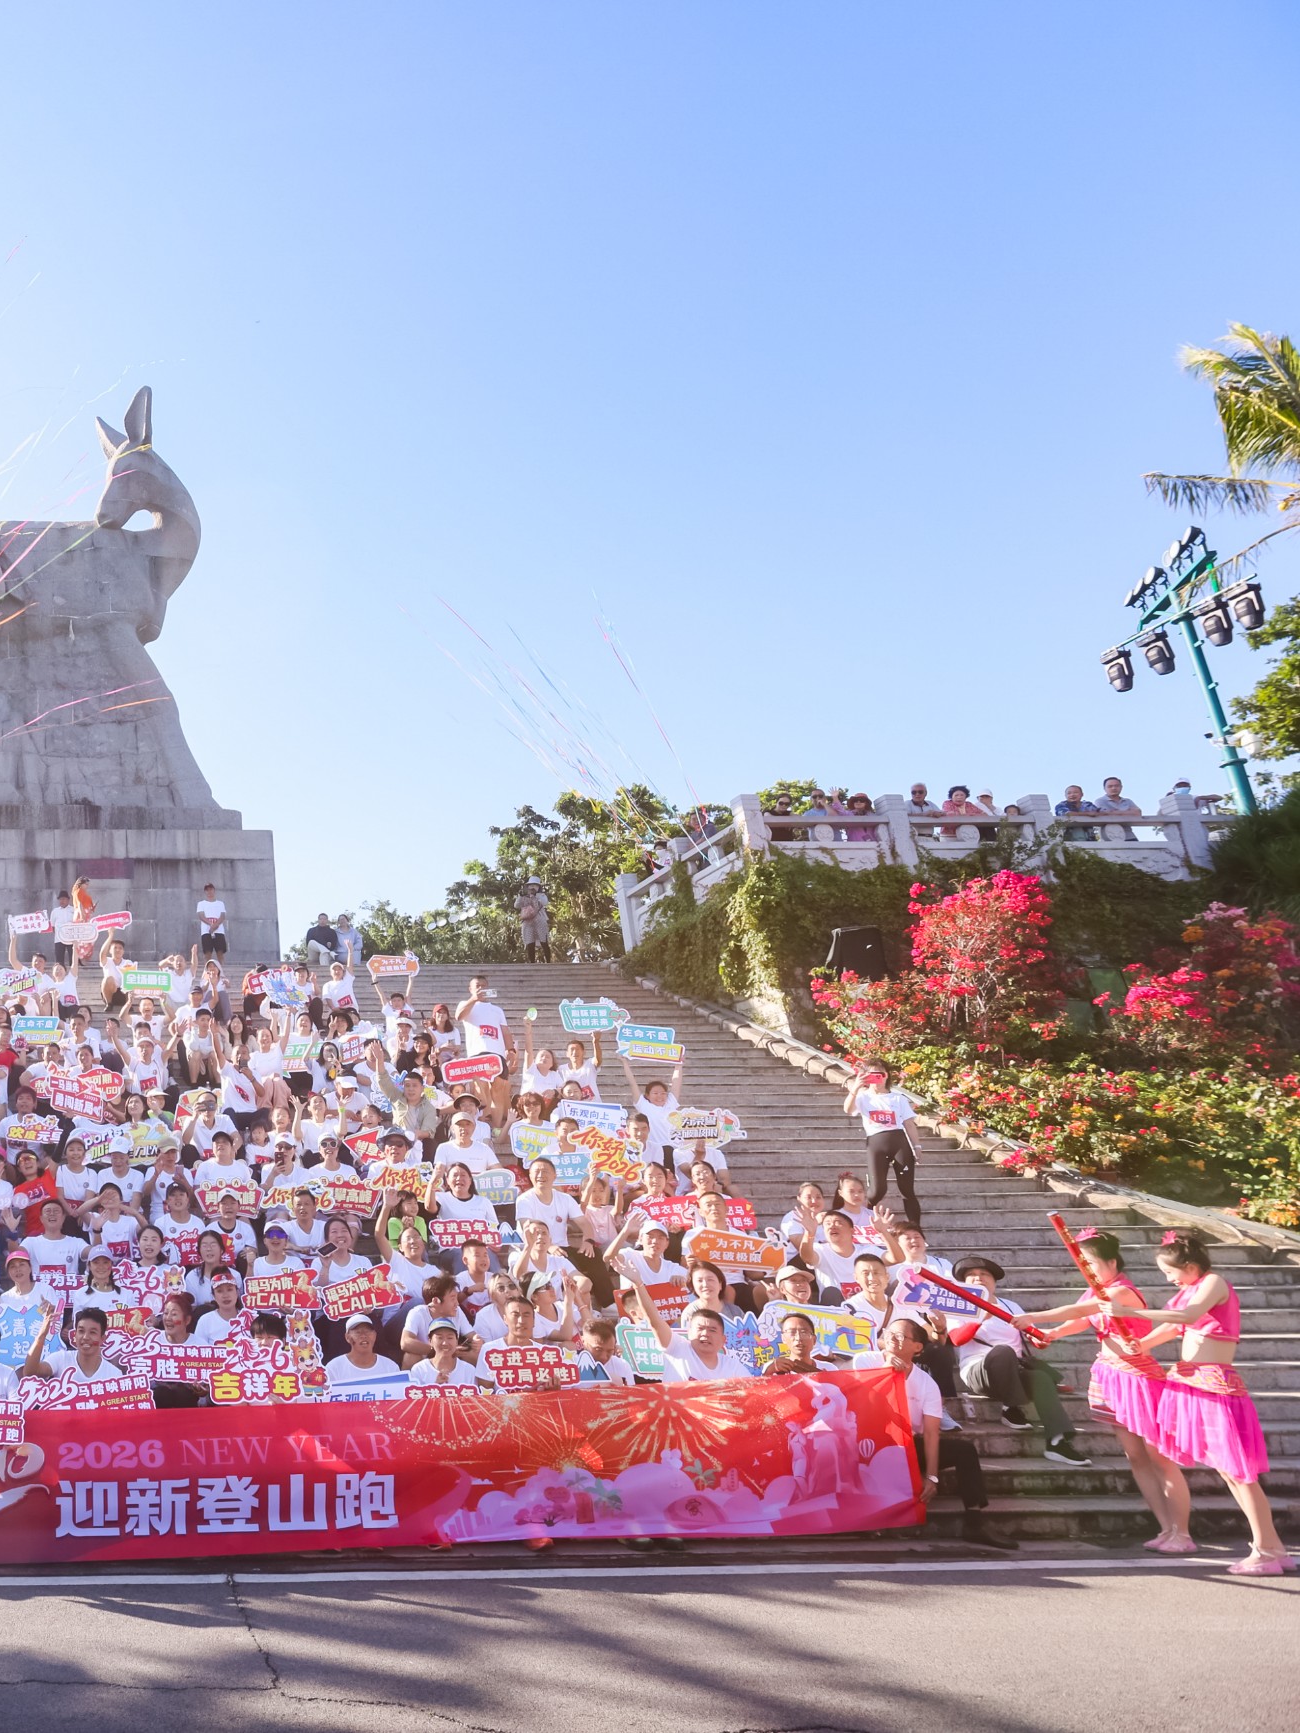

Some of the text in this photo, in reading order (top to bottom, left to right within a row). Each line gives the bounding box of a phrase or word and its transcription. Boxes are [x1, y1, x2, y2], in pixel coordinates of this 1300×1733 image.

[18, 1019, 54, 1029] 生命不息
[622, 1027, 669, 1042] 生命不息
[632, 1045, 680, 1058] 运动不止
[51, 1079, 80, 1094] 一马当先
[54, 1093, 96, 1116] 勇闯新局
[569, 1107, 611, 1121] 乐观向上
[872, 1113, 892, 1122] 188
[8, 1126, 64, 1144] 欢度元旦
[85, 1129, 126, 1150] ports
[572, 1128, 625, 1156] 你好
[556, 1167, 585, 1178] 生活人
[597, 1152, 641, 1182] 2026
[334, 1188, 374, 1204] 攀高峰
[433, 1221, 487, 1234] 奋进马年
[110, 1245, 128, 1255] 127
[716, 1238, 756, 1251] 为不凡
[709, 1250, 763, 1264] 突破极限
[247, 1276, 294, 1294] 福马为你
[325, 1275, 372, 1303] 福马为你
[246, 1292, 302, 1310] 打CALL
[328, 1292, 384, 1318] 打CALL
[652, 1293, 691, 1309] 回头风景区
[105, 1331, 160, 1358] 2026
[160, 1345, 227, 1358] 马踏映骄阳
[488, 1349, 560, 1366] 奋进马年
[130, 1357, 180, 1380] 完胜
[499, 1366, 577, 1384] 开局必胜!
[79, 1376, 148, 1397] 马踏映骄阳
[213, 1372, 299, 1400] 吉祥年
[107, 1396, 129, 1406] GREAT
[129, 1392, 151, 1402] START
[0, 1419, 22, 1428] START
[58, 1432, 397, 1470] 2026 NEW YEAR
[55, 1471, 400, 1539] 迎新登山跑
